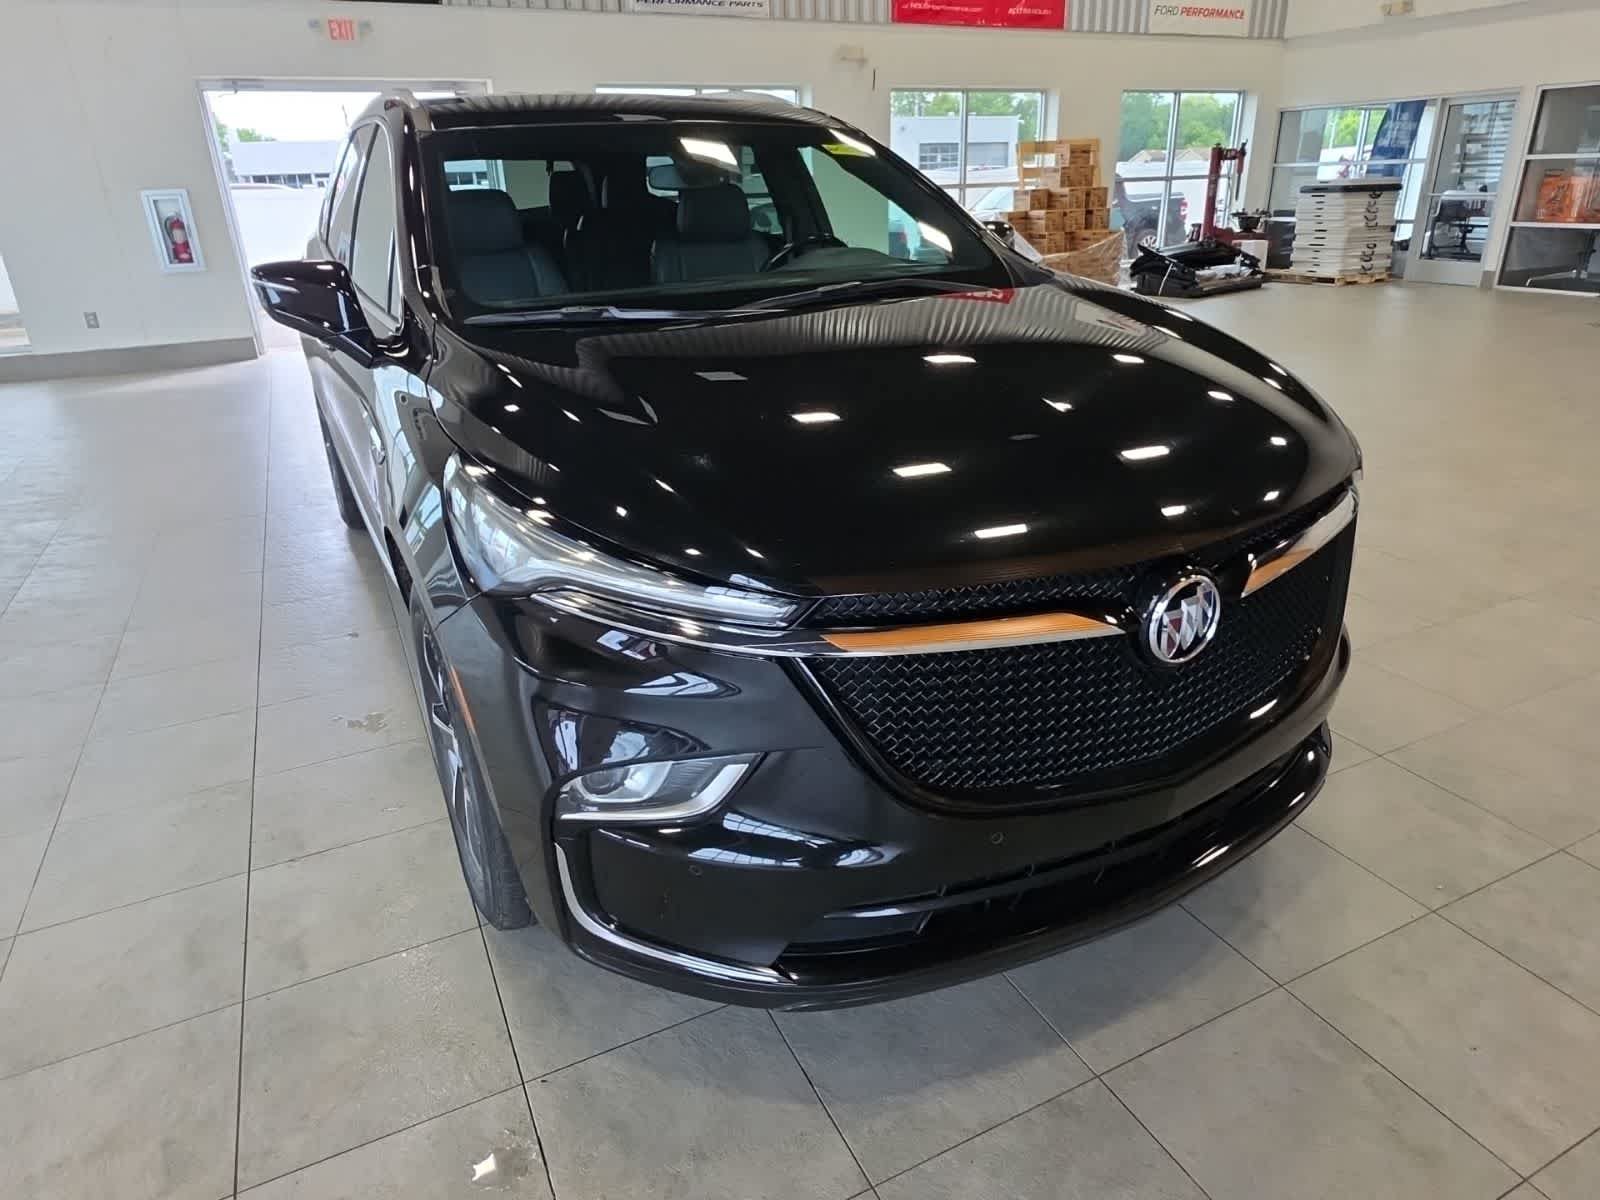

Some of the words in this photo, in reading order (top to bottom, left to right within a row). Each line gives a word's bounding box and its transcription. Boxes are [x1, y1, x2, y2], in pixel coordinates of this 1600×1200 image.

[1154, 5, 1179, 16] FORD
[1180, 7, 1245, 19] PERFORMANCE
[328, 20, 355, 41] EXIT
